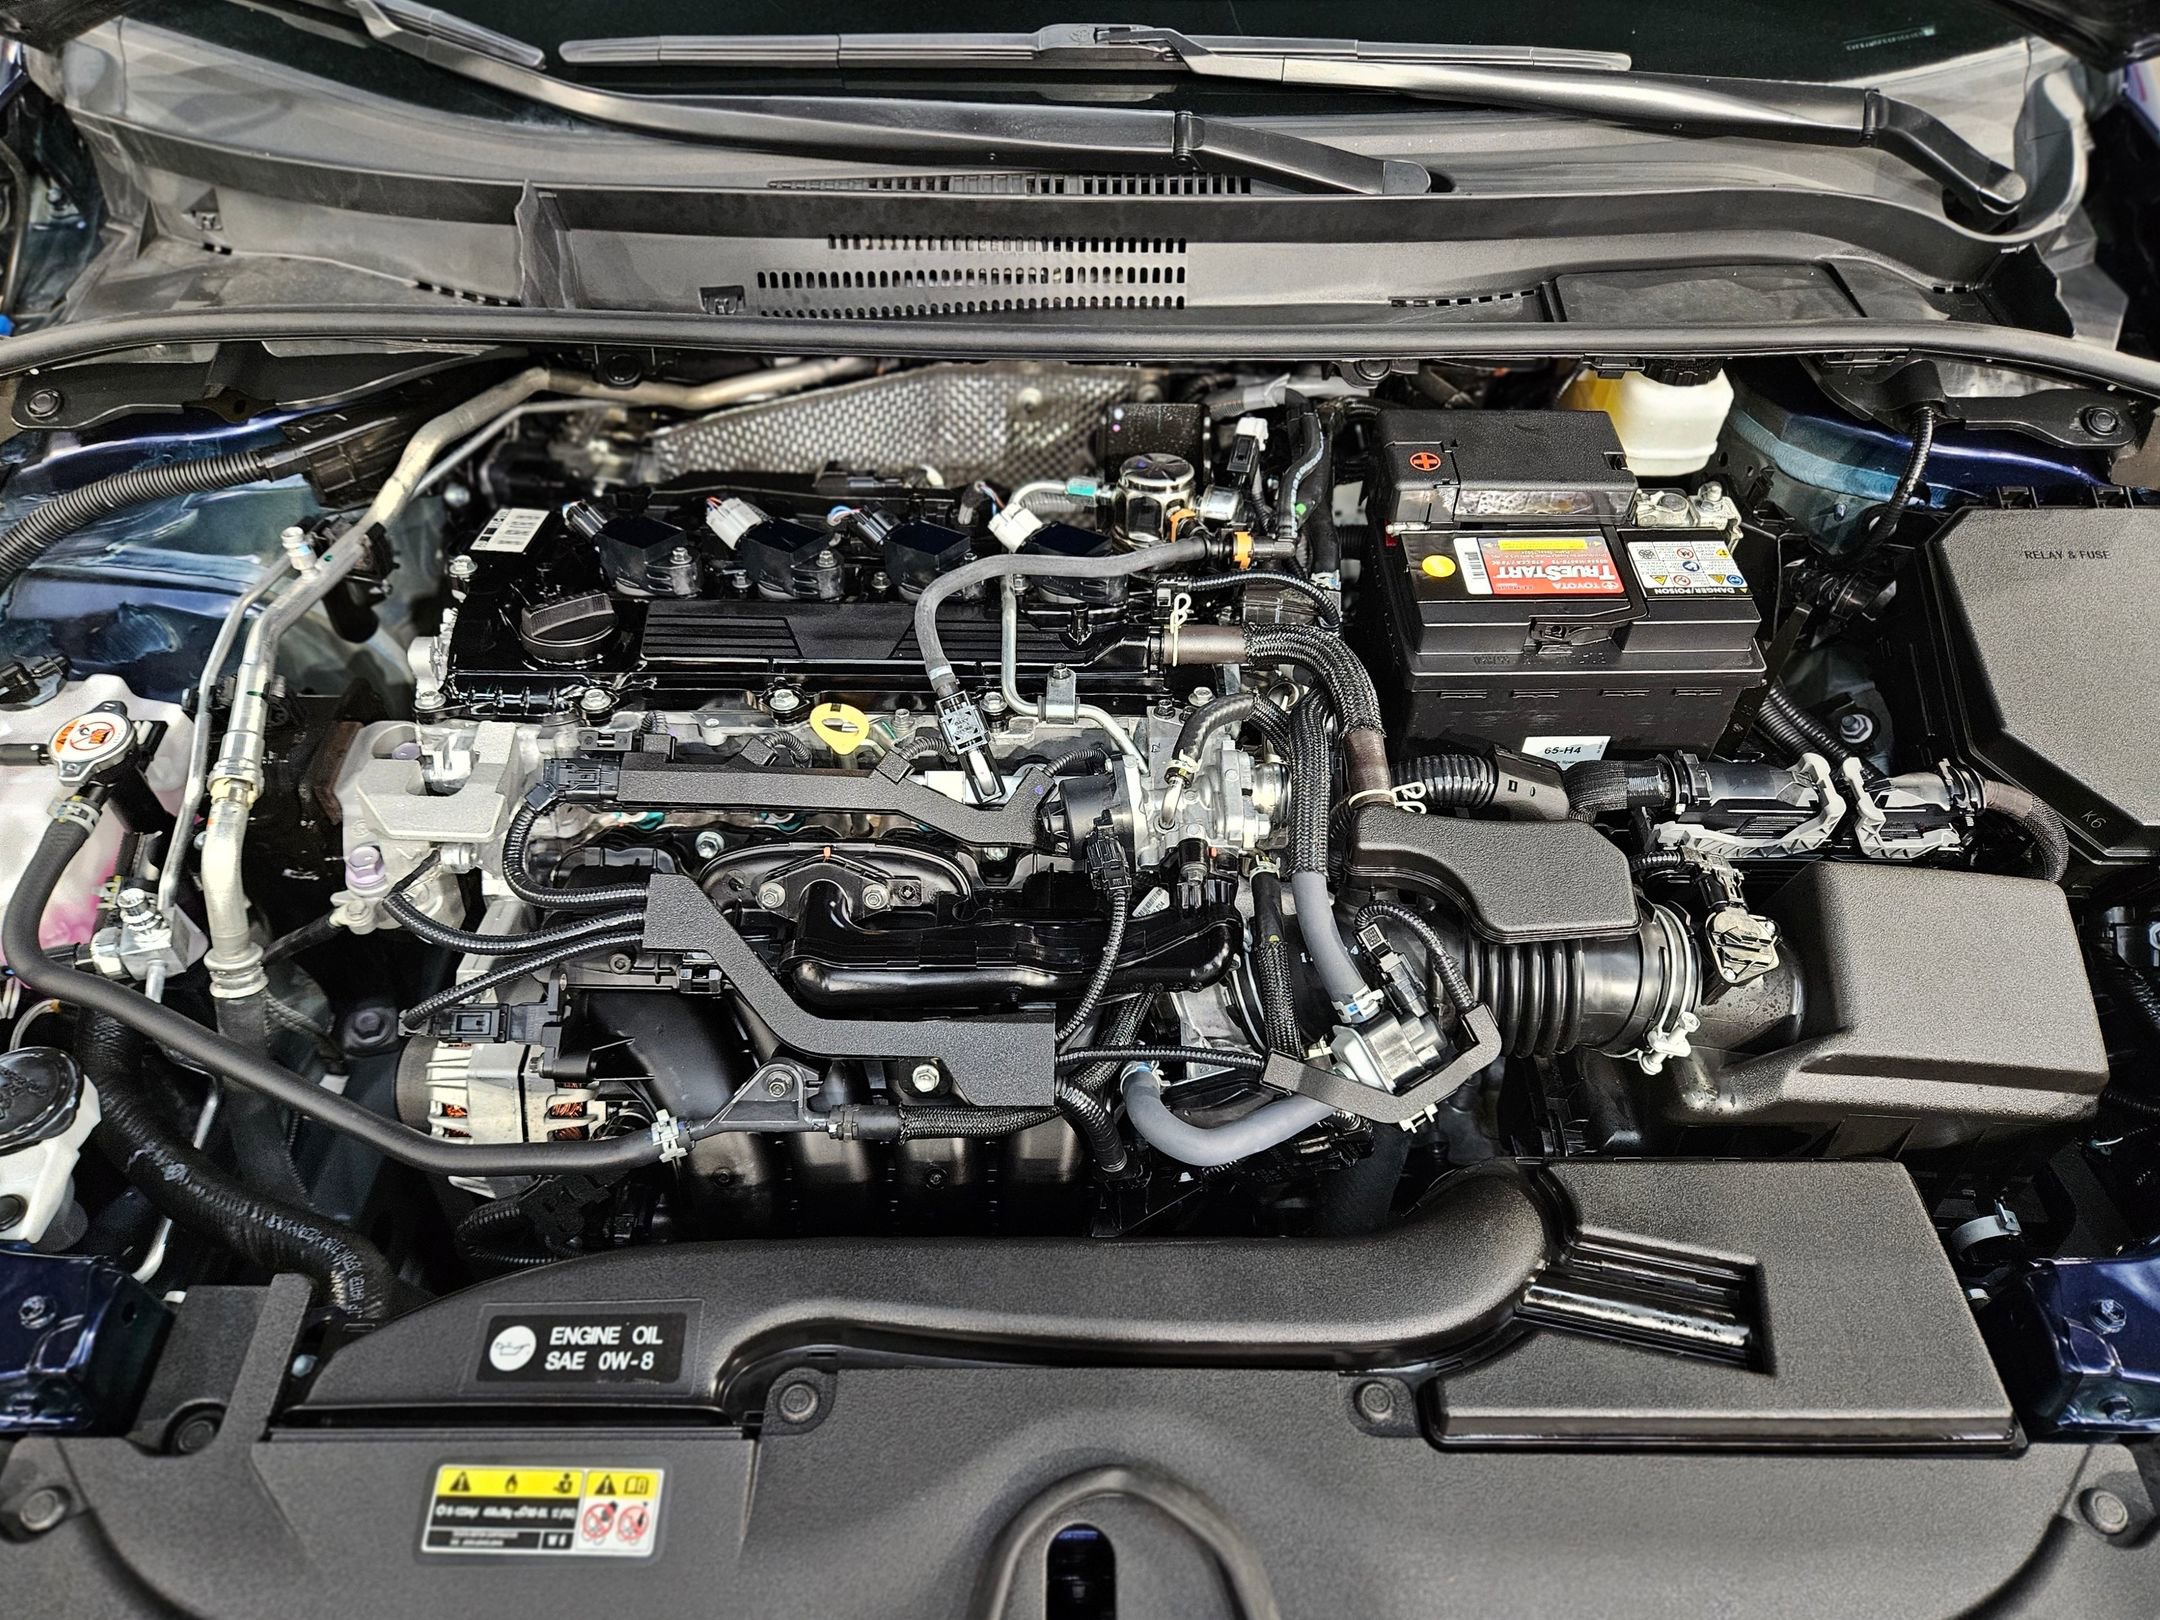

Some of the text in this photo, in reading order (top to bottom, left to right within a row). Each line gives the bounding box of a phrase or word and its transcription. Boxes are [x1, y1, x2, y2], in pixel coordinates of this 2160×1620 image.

[2024, 550, 2111, 560] RELAY & FUSE
[1552, 582, 1601, 591] TOYOTA
[1544, 746, 1582, 755] 65-H4
[2080, 810, 2107, 829] K6
[549, 1325, 665, 1346] ENGINE OIL
[544, 1350, 656, 1372] SAE 0W-8
